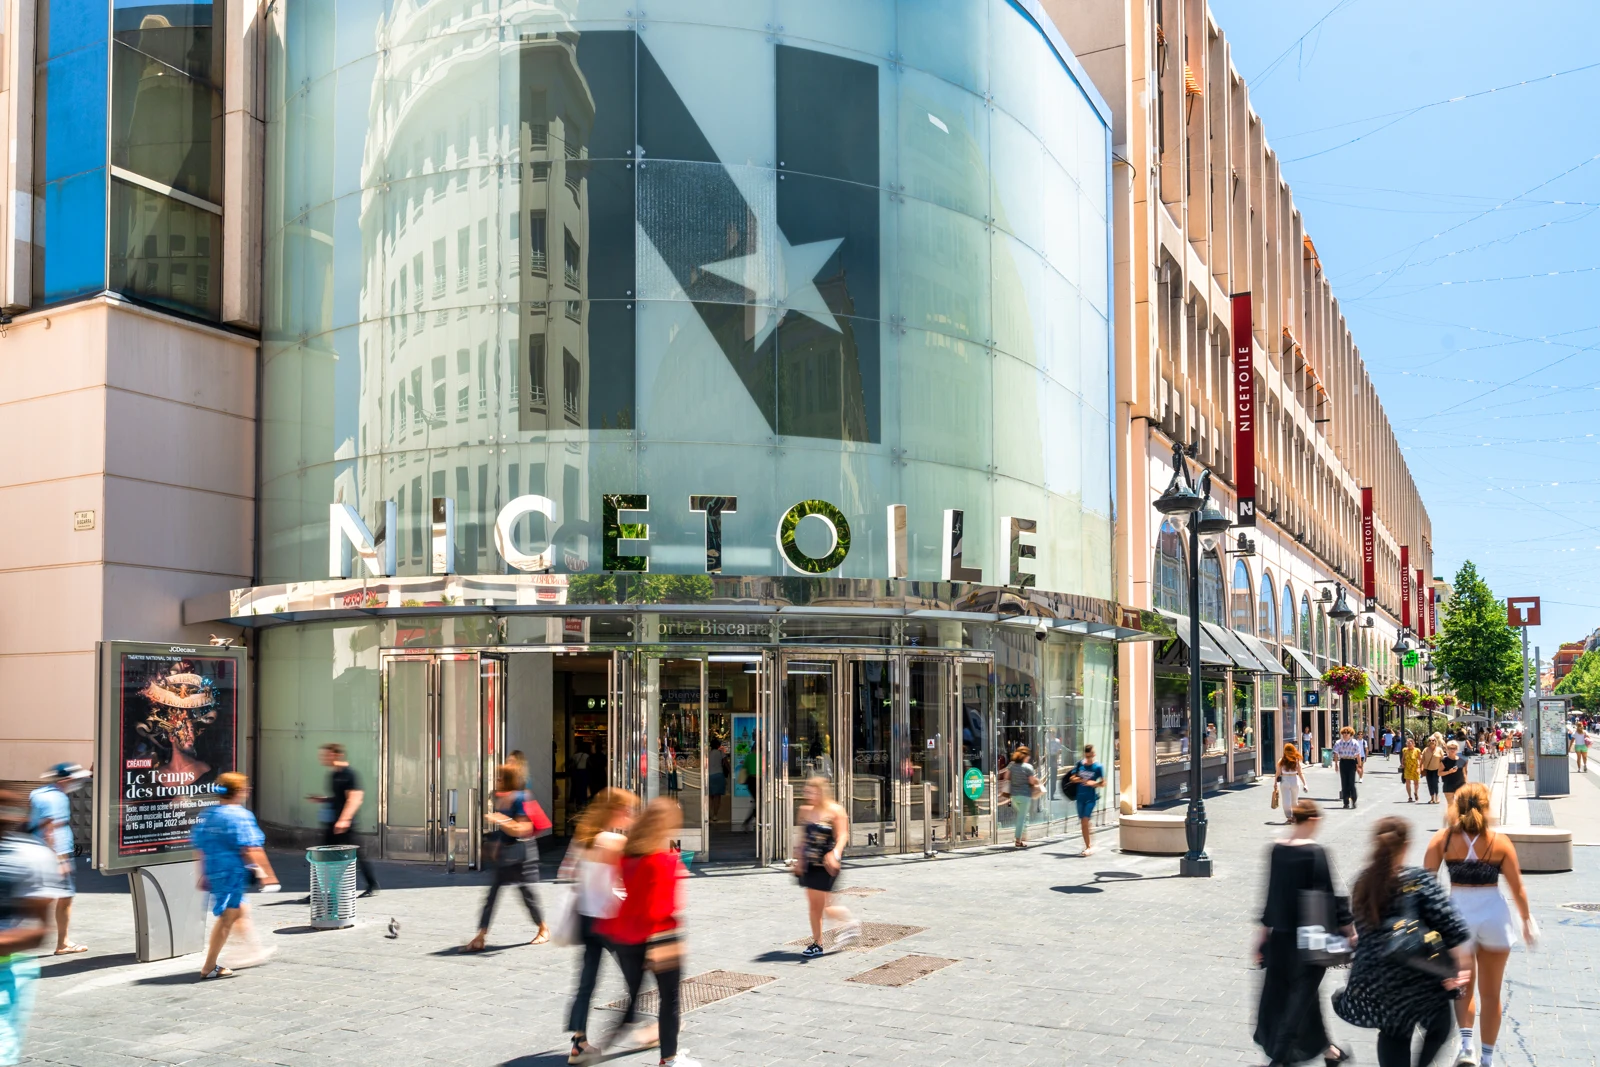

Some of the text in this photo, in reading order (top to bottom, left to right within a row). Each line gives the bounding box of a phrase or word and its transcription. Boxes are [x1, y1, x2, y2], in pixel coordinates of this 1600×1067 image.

[1239, 346, 1250, 432] NICETOILE
[1240, 501, 1253, 516] N
[329, 493, 1037, 588] NICETOILE
[1513, 602, 1536, 622] T
[698, 619, 768, 635] Biscarra
[668, 690, 720, 699] bienveue
[1162, 707, 1181, 728] habitat
[126, 758, 152, 768] CRÉATION
[126, 770, 194, 785] Le Temps
[126, 782, 220, 798] des trompette
[126, 804, 138, 813] Texte,
[126, 812, 142, 822] Création
[143, 812, 162, 820] musicale
[172, 810, 186, 819] Lagier
[132, 822, 139, 830] 15
[153, 820, 163, 830] juin
[164, 819, 177, 827] 2022
